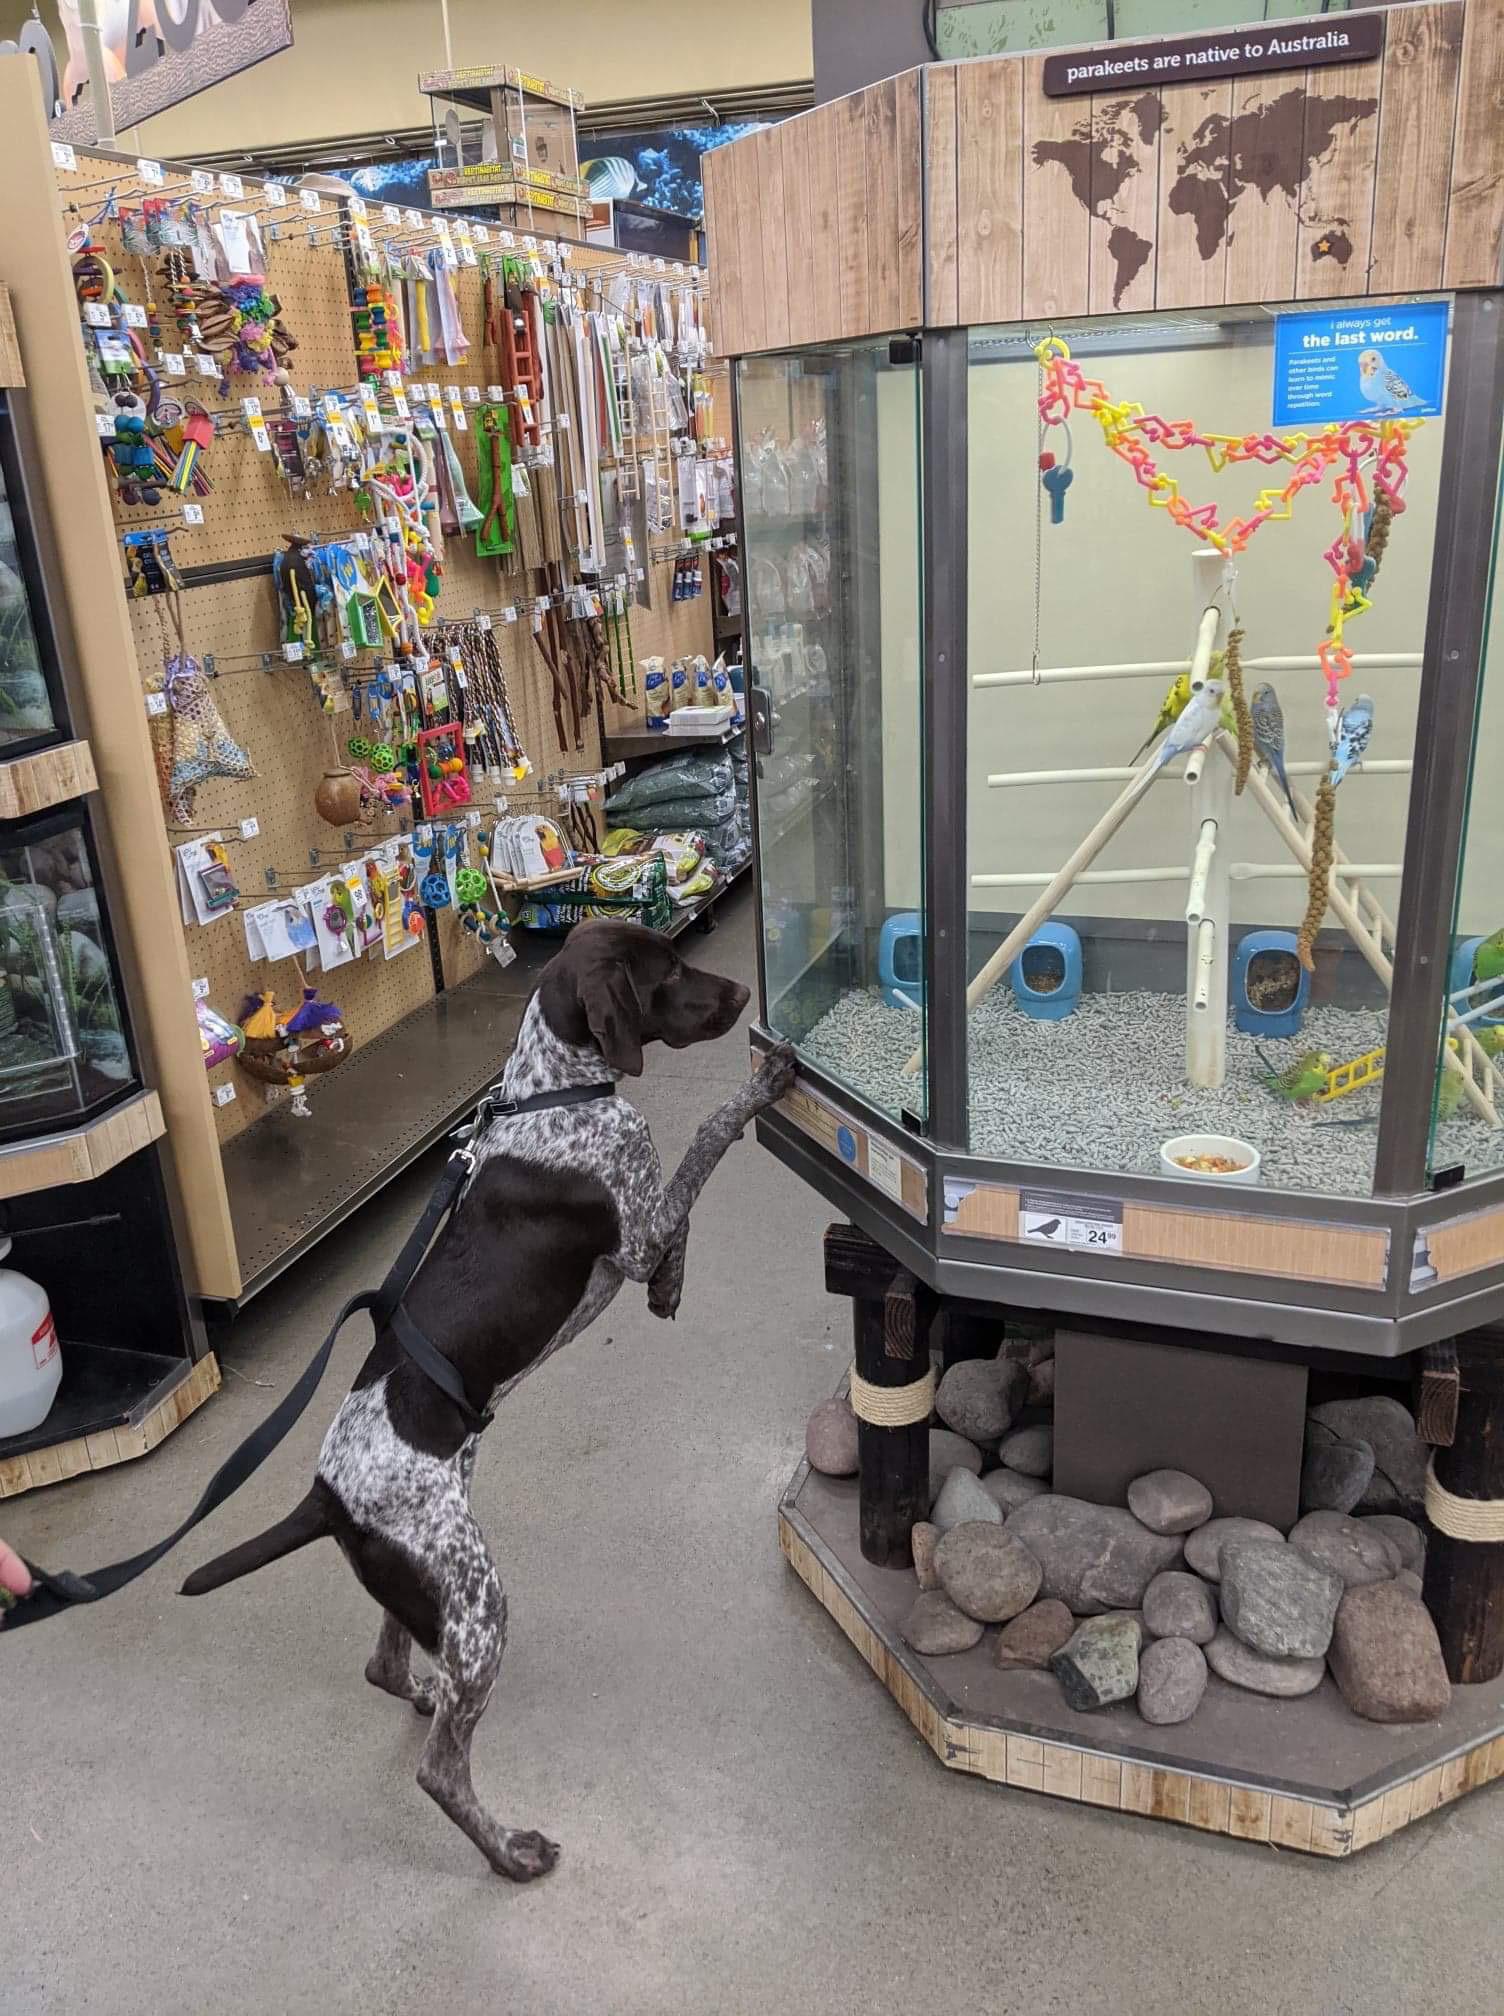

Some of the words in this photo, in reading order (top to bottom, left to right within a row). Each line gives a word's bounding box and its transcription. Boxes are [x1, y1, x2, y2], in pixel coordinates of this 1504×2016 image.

[1067, 59, 1149, 83] parakeets
[1153, 52, 1181, 70] are
[1185, 46, 1240, 66] native
[1245, 43, 1264, 59] to
[1267, 31, 1350, 56] Australia
[1336, 318, 1371, 330] always
[1373, 317, 1392, 328] get
[1302, 333, 1331, 348] the
[1335, 331, 1366, 346] last
[1370, 326, 1419, 342] word.
